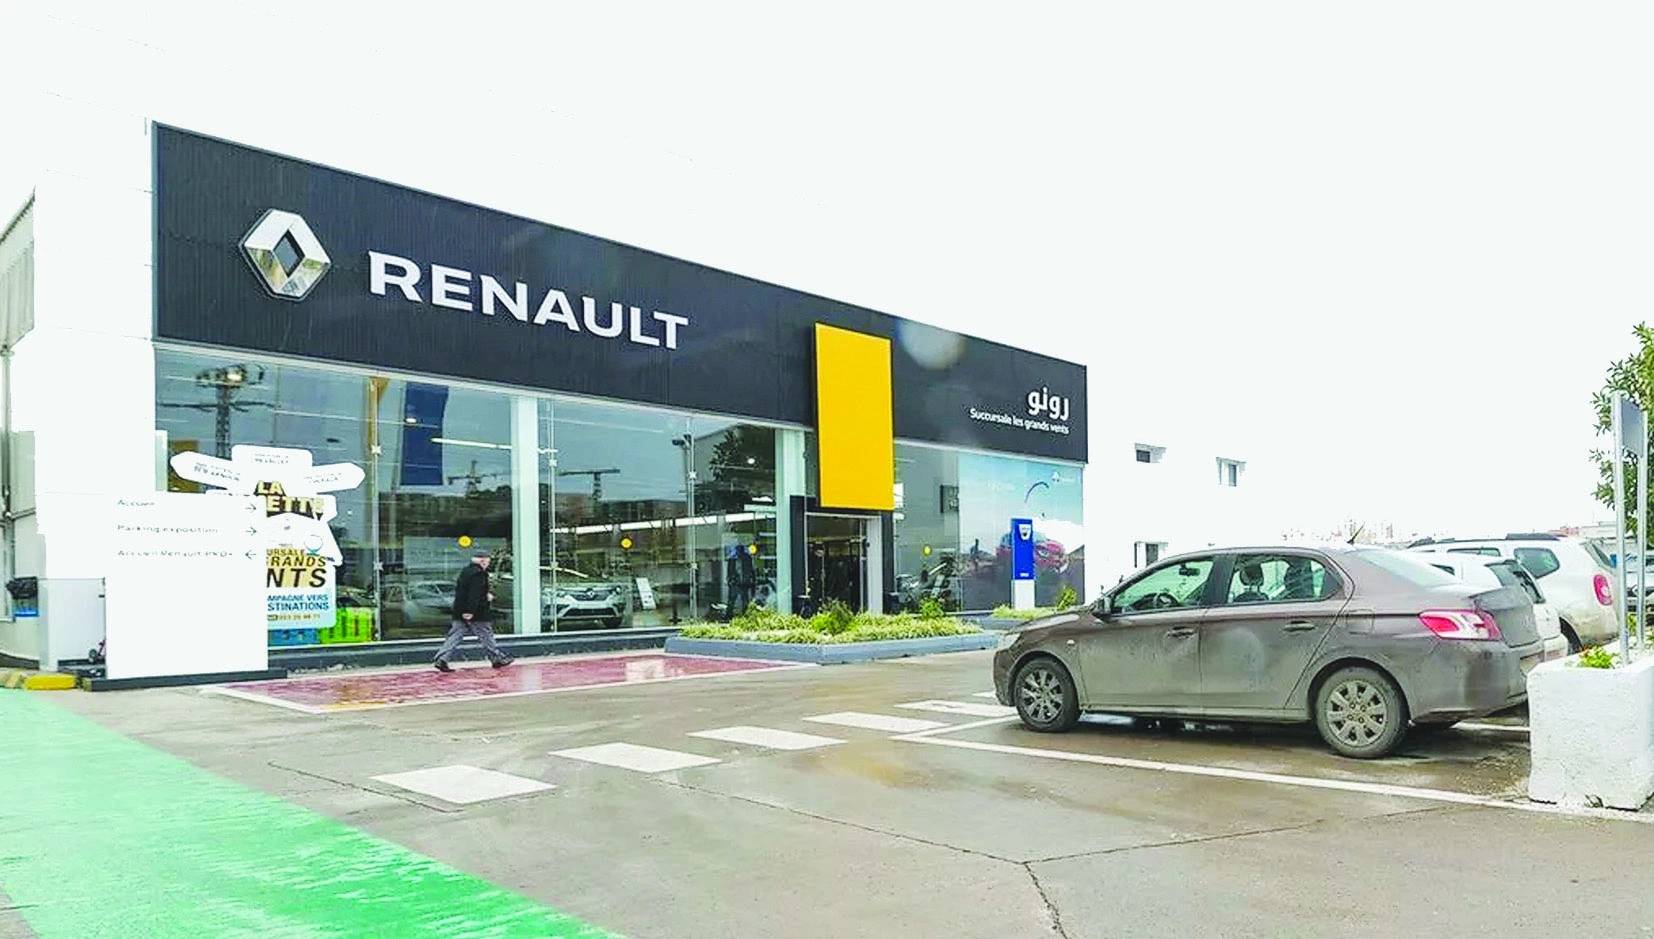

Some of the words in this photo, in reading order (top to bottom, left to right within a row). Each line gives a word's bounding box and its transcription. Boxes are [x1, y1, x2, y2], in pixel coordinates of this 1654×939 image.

[368, 250, 689, 350] RENAULT
[1027, 386, 1070, 421] رونو
[970, 407, 1012, 425] Succursale
[1013, 415, 1024, 427] les
[1024, 419, 1050, 430] grands
[1050, 424, 1070, 434] vents
[265, 556, 326, 567] RANDS
[266, 548, 304, 556] URSALE
[266, 567, 327, 588] NTS
[267, 601, 330, 612] STINATIONS
